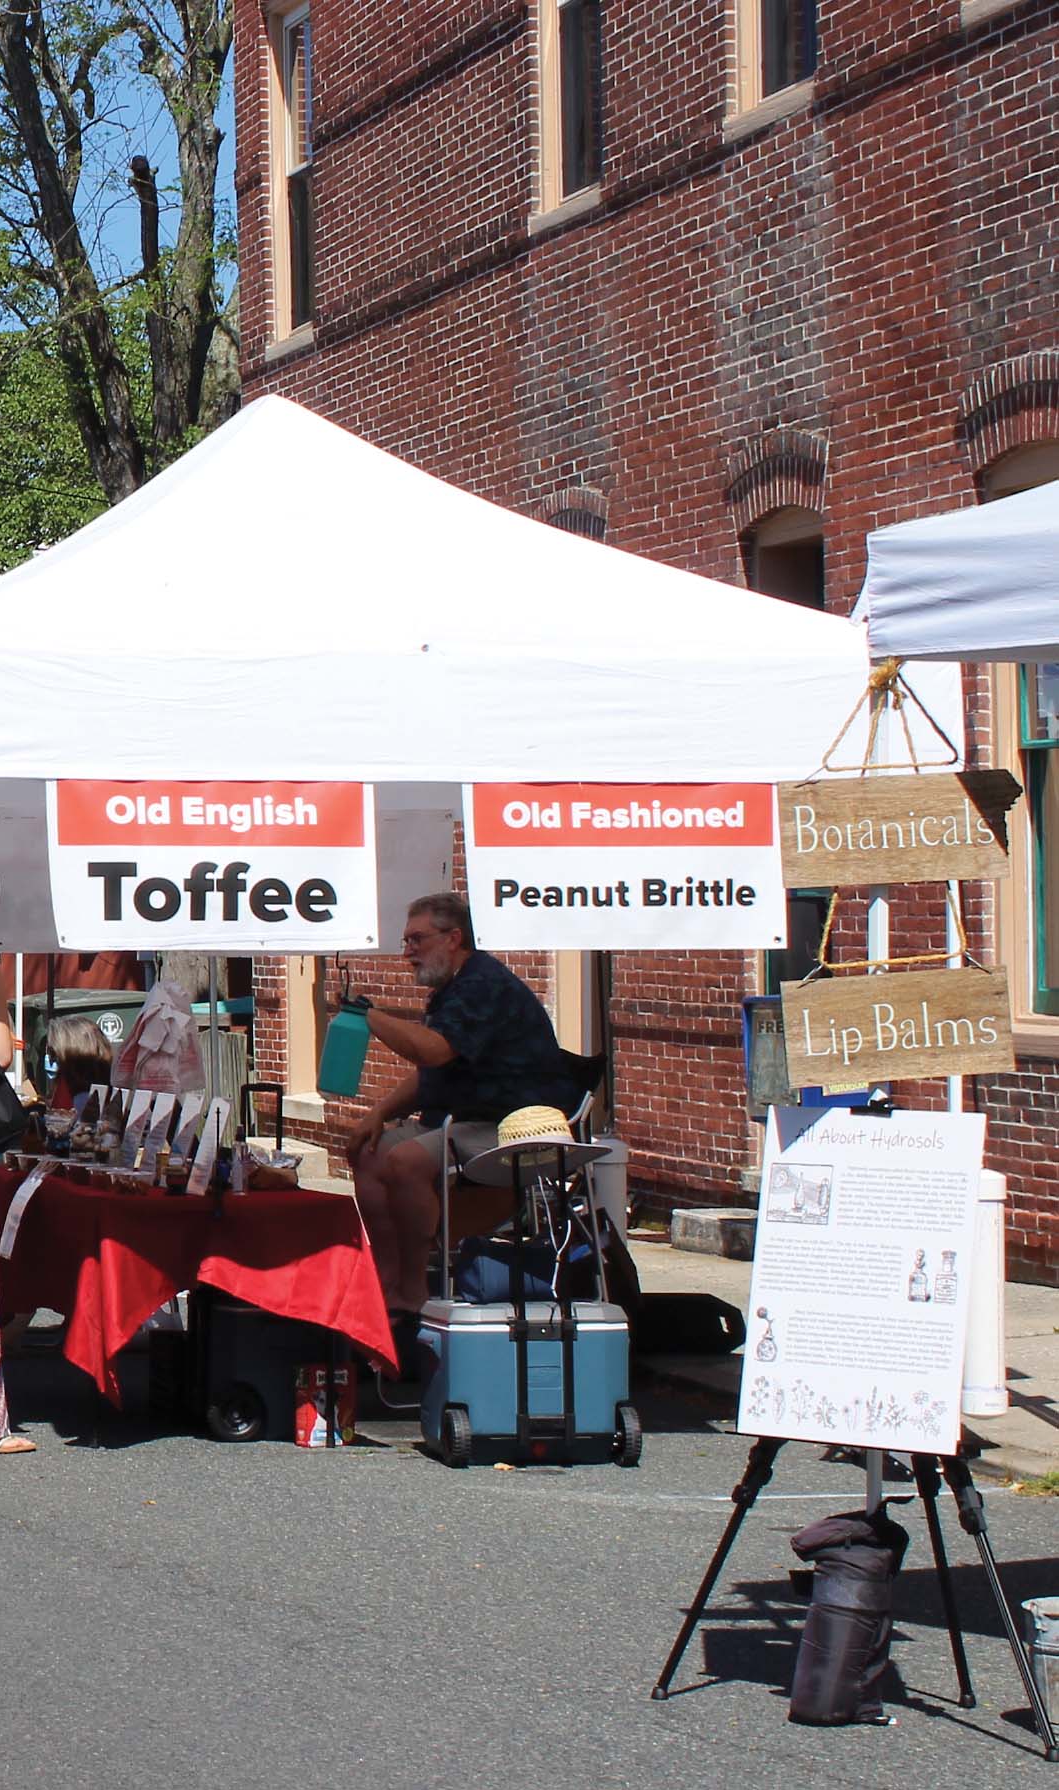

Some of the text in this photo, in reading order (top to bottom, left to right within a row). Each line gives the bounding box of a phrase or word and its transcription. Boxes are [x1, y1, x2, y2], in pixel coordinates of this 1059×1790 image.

[105, 795, 318, 833] Old English
[502, 799, 746, 829] Old Fashioned
[793, 798, 995, 854] Botanicals
[87, 861, 338, 923] Toffee
[494, 876, 757, 908] Peanut Brittle
[802, 1001, 998, 1066] Lip Balms
[820, 1127, 866, 1145] About
[869, 1127, 945, 1151] Hydrosols
